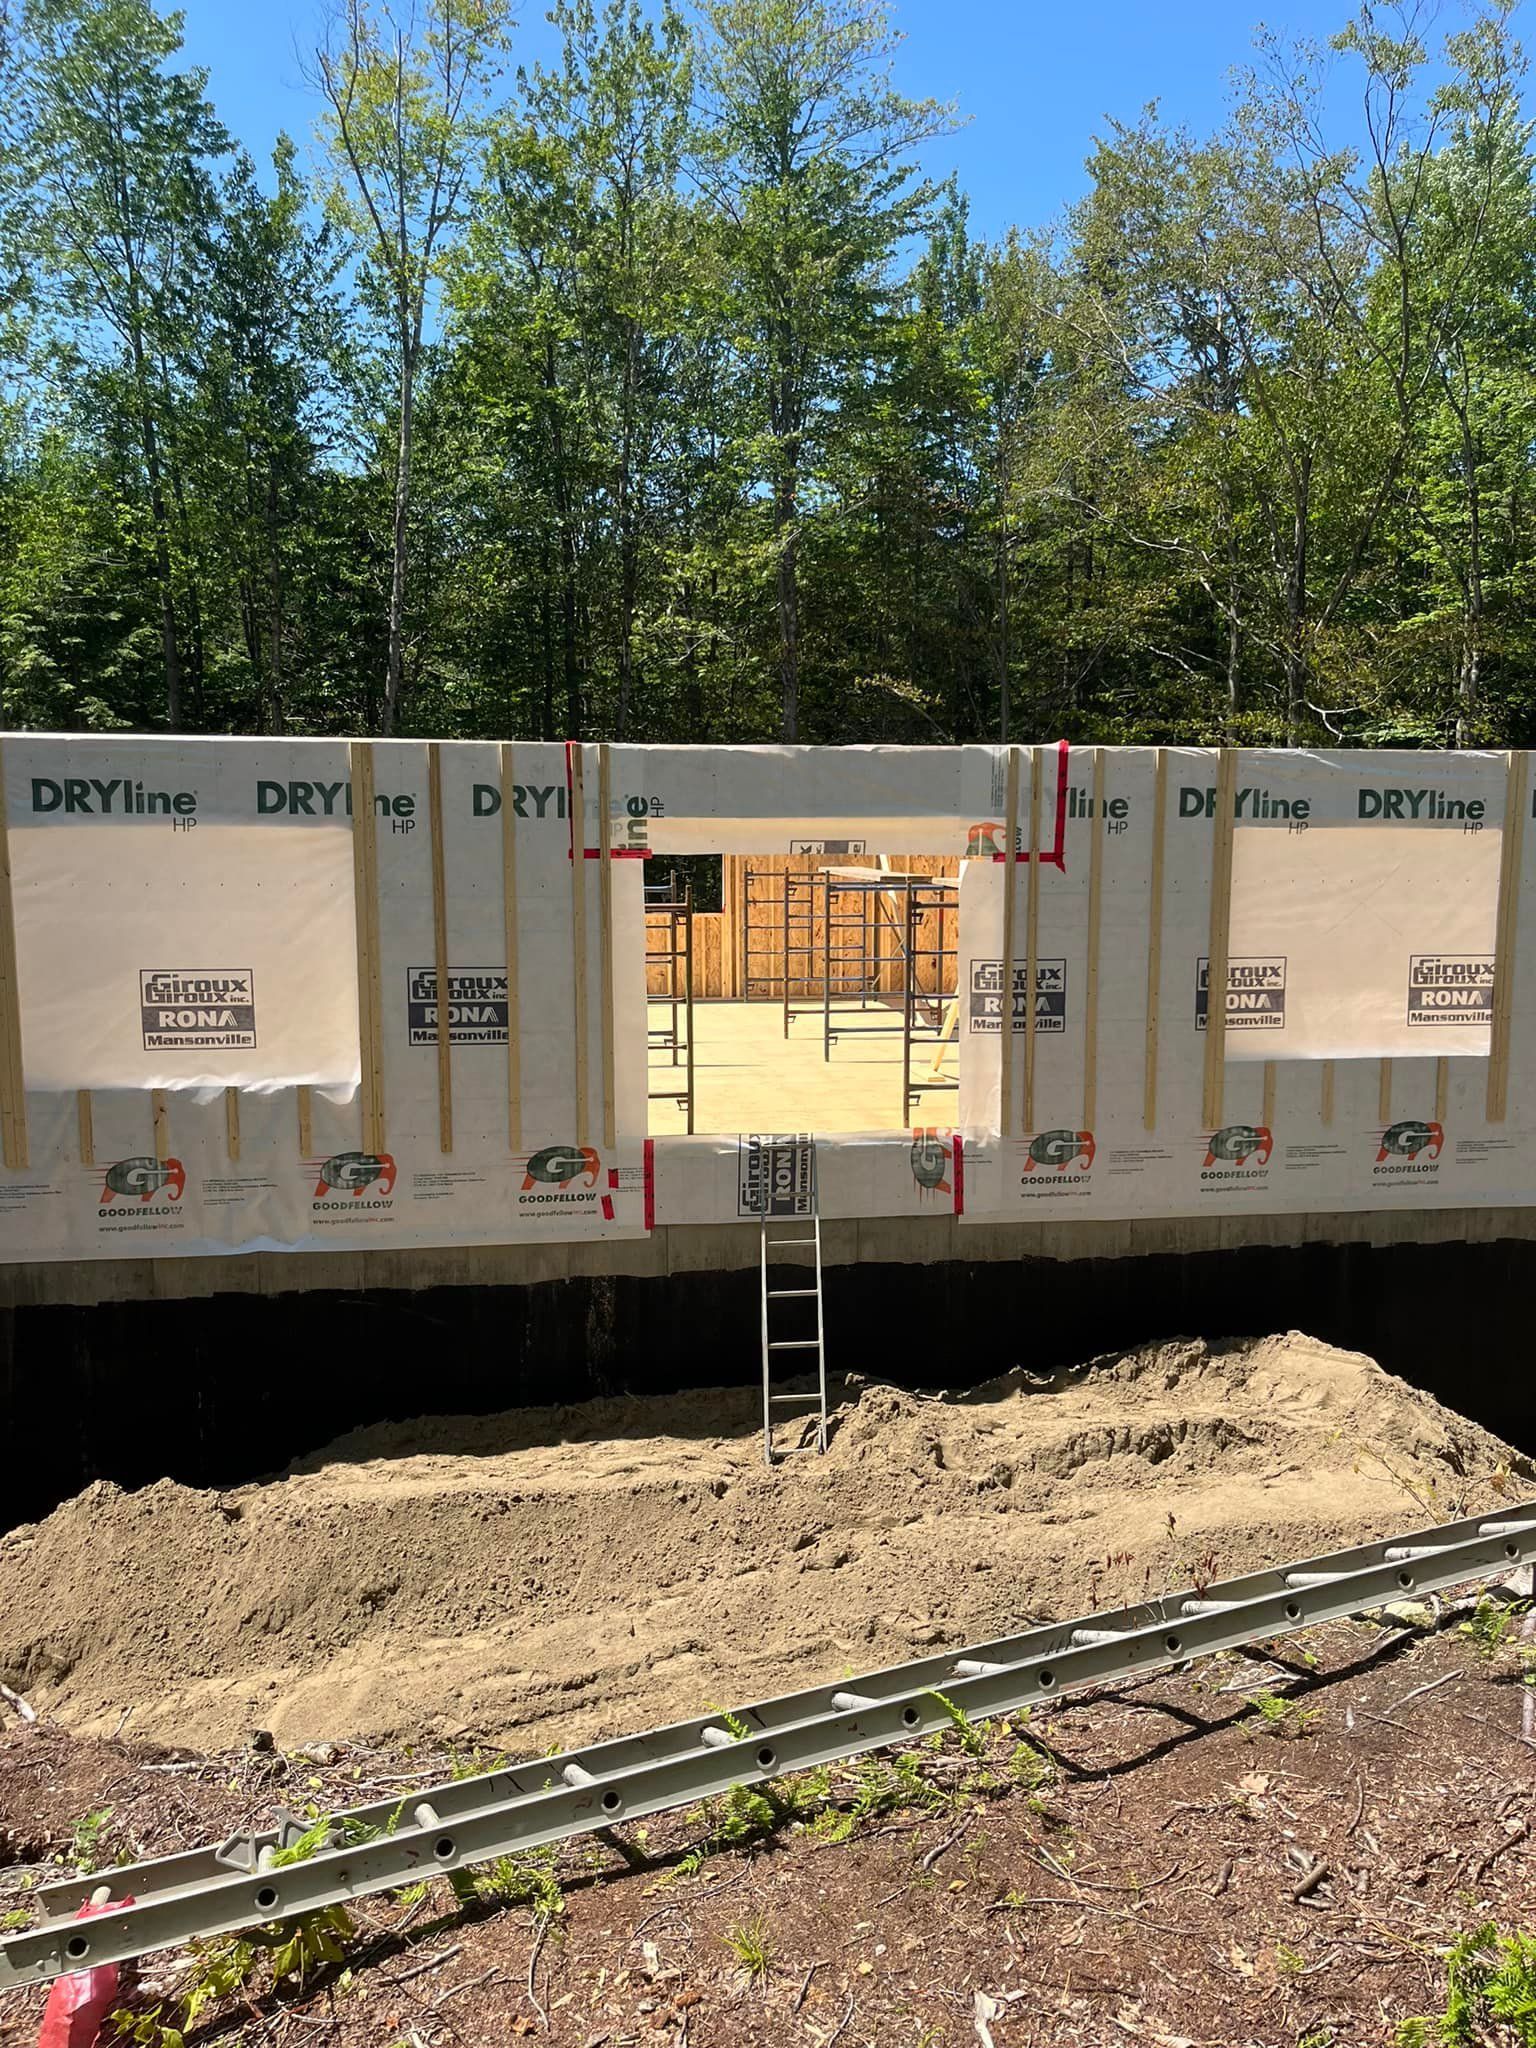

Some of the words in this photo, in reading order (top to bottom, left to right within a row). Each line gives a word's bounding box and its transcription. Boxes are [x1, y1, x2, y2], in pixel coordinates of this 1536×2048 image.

[31, 778, 197, 815] DRYline
[257, 781, 416, 817] DRYlne
[473, 784, 566, 819] DRYl
[1068, 787, 1129, 819] line
[1358, 789, 1486, 820] DRYline
[173, 818, 197, 832] HP
[392, 819, 416, 834] HP
[1107, 821, 1128, 834] HP
[1288, 822, 1309, 834] HP
[1463, 822, 1484, 834] HP
[1419, 959, 1495, 975] Giroux
[151, 974, 249, 993] Giroux
[418, 971, 508, 989] Groux
[145, 982, 229, 1004] Giroux
[412, 980, 491, 1000] Gioux
[1225, 994, 1272, 1010] ONA
[1421, 991, 1484, 1006] RONA
[159, 1010, 239, 1028] RONA
[1198, 1016, 1282, 1027] Msonville
[147, 1034, 253, 1046] Mansonville
[413, 1030, 509, 1041] Masonville
[1373, 1165, 1440, 1175] GOODFELLOW
[312, 1200, 394, 1211] GOODFELLOW
[518, 1193, 597, 1204] GOODFELLOW
[98, 1206, 184, 1217] GOODFELLOW
